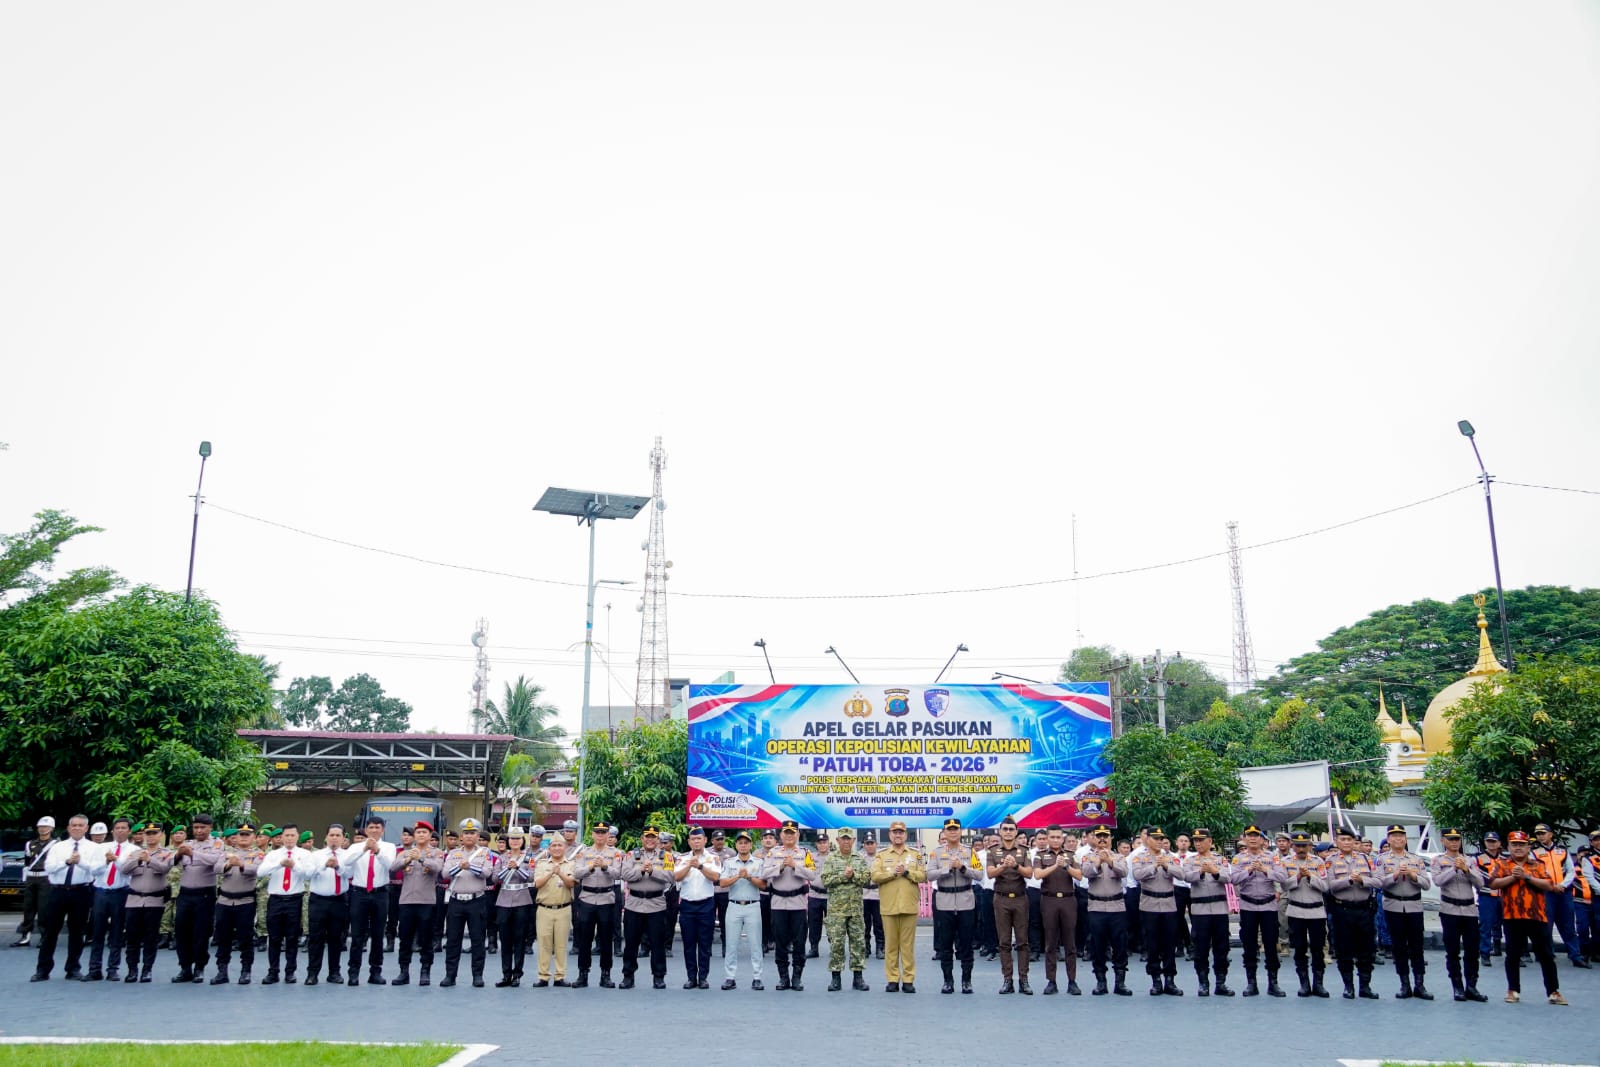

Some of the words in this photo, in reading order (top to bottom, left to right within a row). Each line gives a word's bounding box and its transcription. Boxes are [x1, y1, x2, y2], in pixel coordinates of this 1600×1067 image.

[803, 721, 847, 737] APEL
[852, 721, 907, 737] GELAR
[912, 721, 992, 736] PASUKAN
[767, 738, 831, 754] OPERASI
[834, 738, 922, 755] KEPOLISIAN
[925, 738, 1031, 754] KEWILAYAHAN
[813, 757, 873, 772] PATUH
[877, 757, 927, 772] TOBA
[941, 757, 985, 772] 2026
[807, 775, 834, 784] POLISI
[836, 775, 876, 784] BERSAMA
[878, 775, 935, 784] MASYARAKAT
[936, 775, 997, 784] MEWUJUDKAN
[778, 785, 799, 794] LALU
[800, 785, 830, 794] LINTAS
[831, 785, 855, 794] YANG
[856, 785, 889, 794] TERTIB,
[890, 785, 915, 793] AMAN
[916, 785, 935, 793] DAN
[936, 784, 1012, 793] BERKESELAMATAN
[826, 796, 834, 804] DI
[836, 796, 869, 804] WILAYAH
[871, 796, 898, 804] HUKUM
[899, 796, 928, 804] POLRES
[931, 796, 950, 804] BATU
[952, 796, 972, 804] BARA
